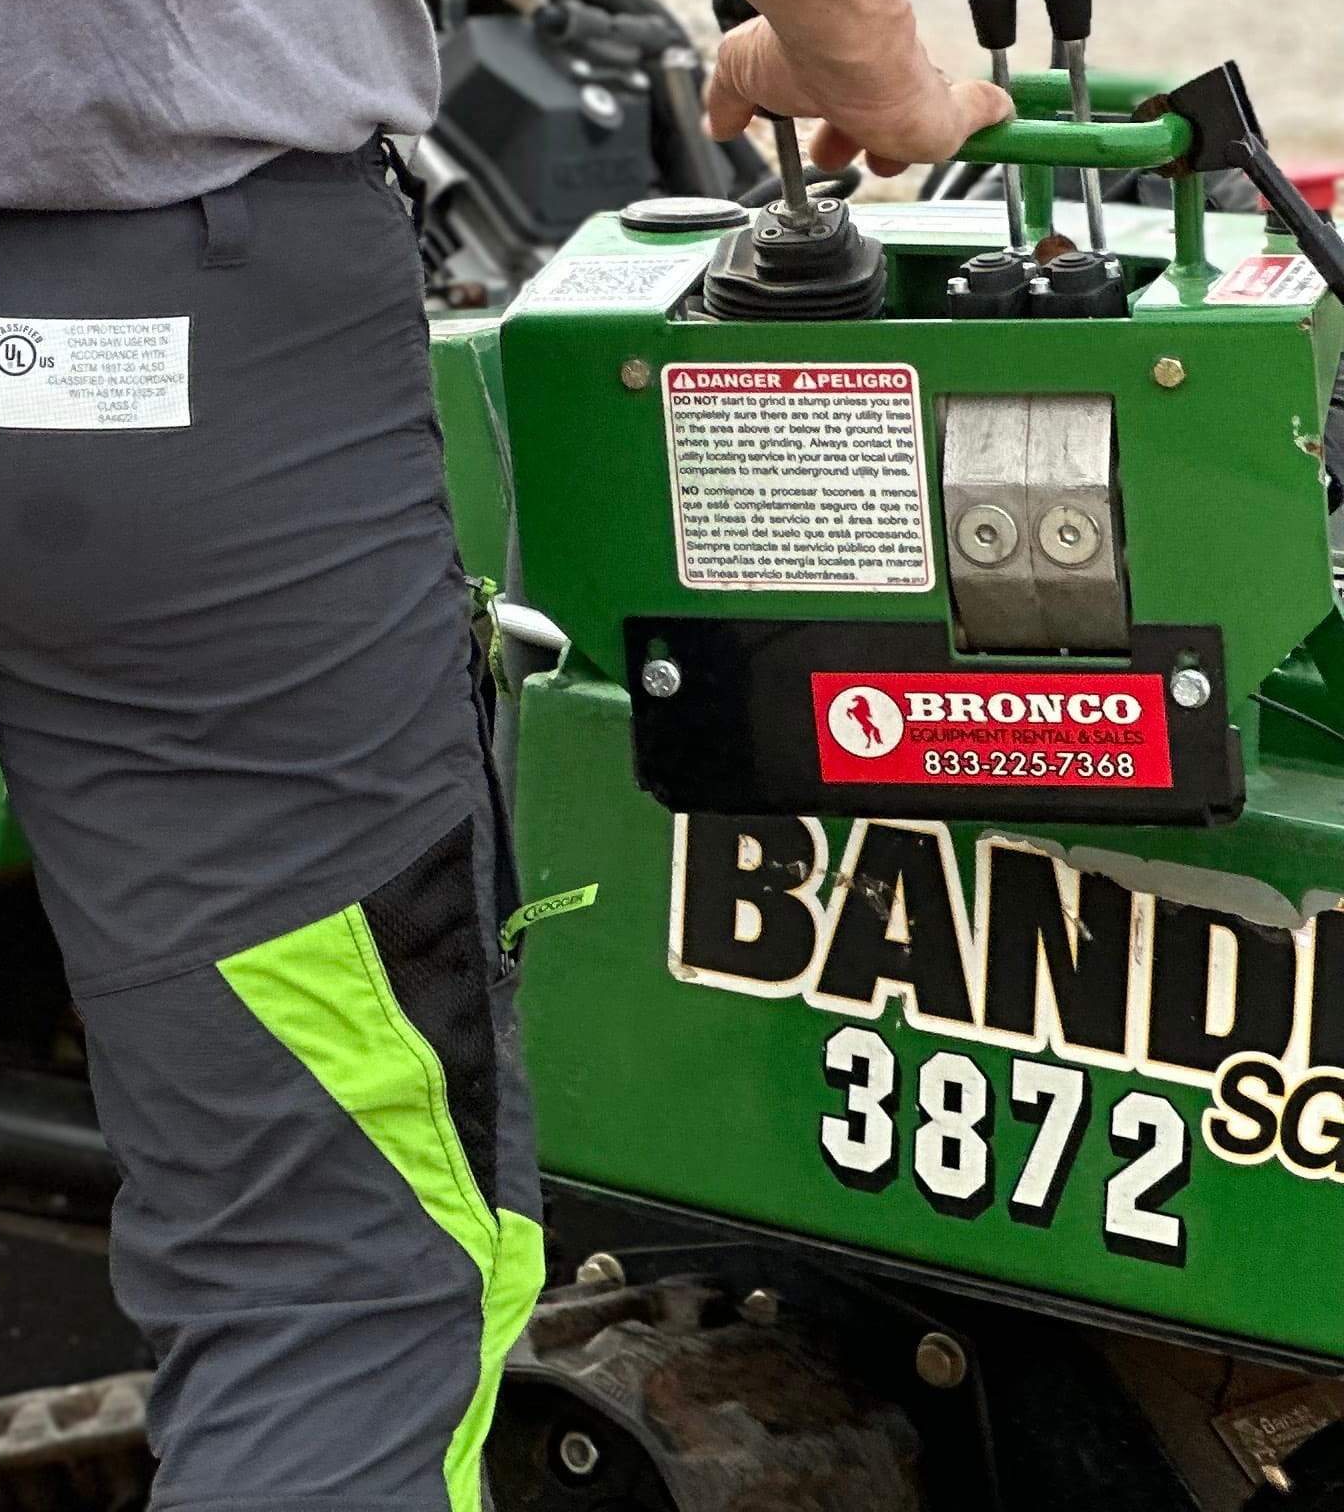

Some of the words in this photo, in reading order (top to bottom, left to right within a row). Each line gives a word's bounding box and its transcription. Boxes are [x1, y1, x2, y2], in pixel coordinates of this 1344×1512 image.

[87, 324, 149, 335] PROTECTION
[151, 323, 171, 334] FOR
[5, 344, 25, 367] UL
[39, 356, 55, 368] US
[70, 350, 139, 360] ACCORDANCE
[48, 375, 105, 385] CLASSIFIED
[119, 373, 185, 385] ACCORDANCE
[697, 374, 781, 387] DANGER
[817, 373, 907, 388] PELIGRO
[674, 396, 690, 405] DO
[694, 396, 718, 405] NOT
[721, 397, 744, 405] start
[747, 397, 756, 405] to
[759, 396, 785, 407] grind
[798, 397, 830, 407] stump
[833, 397, 867, 406] unless
[870, 398, 890, 407] you
[675, 411, 730, 421] completely
[760, 411, 787, 419] there
[833, 412, 851, 422] any
[856, 411, 882, 422] utility
[886, 411, 911, 419] lines
[689, 425, 705, 433] the
[738, 424, 769, 433] above
[789, 425, 820, 433] below
[825, 425, 841, 433] the
[846, 425, 883, 435] ground
[887, 425, 912, 433] level
[677, 438, 709, 446] where
[714, 439, 733, 449] you
[810, 438, 848, 449] Always
[853, 439, 892, 447] contact
[896, 438, 913, 447] the
[679, 452, 704, 463] utility
[706, 453, 746, 463] locating
[798, 454, 820, 463] your
[862, 453, 885, 461] local
[888, 453, 914, 464] utility
[680, 467, 736, 476] companies
[753, 466, 778, 475] mark
[782, 466, 848, 477] underground
[852, 466, 879, 478] utility
[682, 486, 699, 495] NO
[881, 489, 917, 497] menos
[683, 502, 702, 510] que
[821, 503, 857, 512] seguro
[862, 502, 875, 510] de
[880, 504, 900, 512] que
[905, 503, 919, 511] no
[684, 514, 709, 524] haya
[751, 515, 764, 523] de
[834, 515, 843, 524] el
[878, 516, 908, 525] sobre
[685, 528, 708, 539] bajo
[711, 528, 720, 537] el
[724, 528, 748, 537] nivel
[752, 528, 768, 537] del
[772, 529, 800, 537] suelo
[804, 530, 824, 539] que
[687, 541, 730, 552] Siempre
[782, 542, 790, 551] al
[878, 544, 895, 553] del
[758, 556, 771, 565] de
[818, 557, 855, 566] locales
[859, 559, 882, 568] para
[886, 559, 923, 567] marcar
[904, 692, 1142, 724] BRONCO
[911, 727, 1008, 743] EQUIPMENT
[1012, 728, 1075, 744] RENTAL
[1077, 729, 1093, 745] &
[1093, 729, 1144, 745] SALES
[924, 750, 1135, 777] 833-225-7368
[820, 1025, 1188, 1263] 3872
